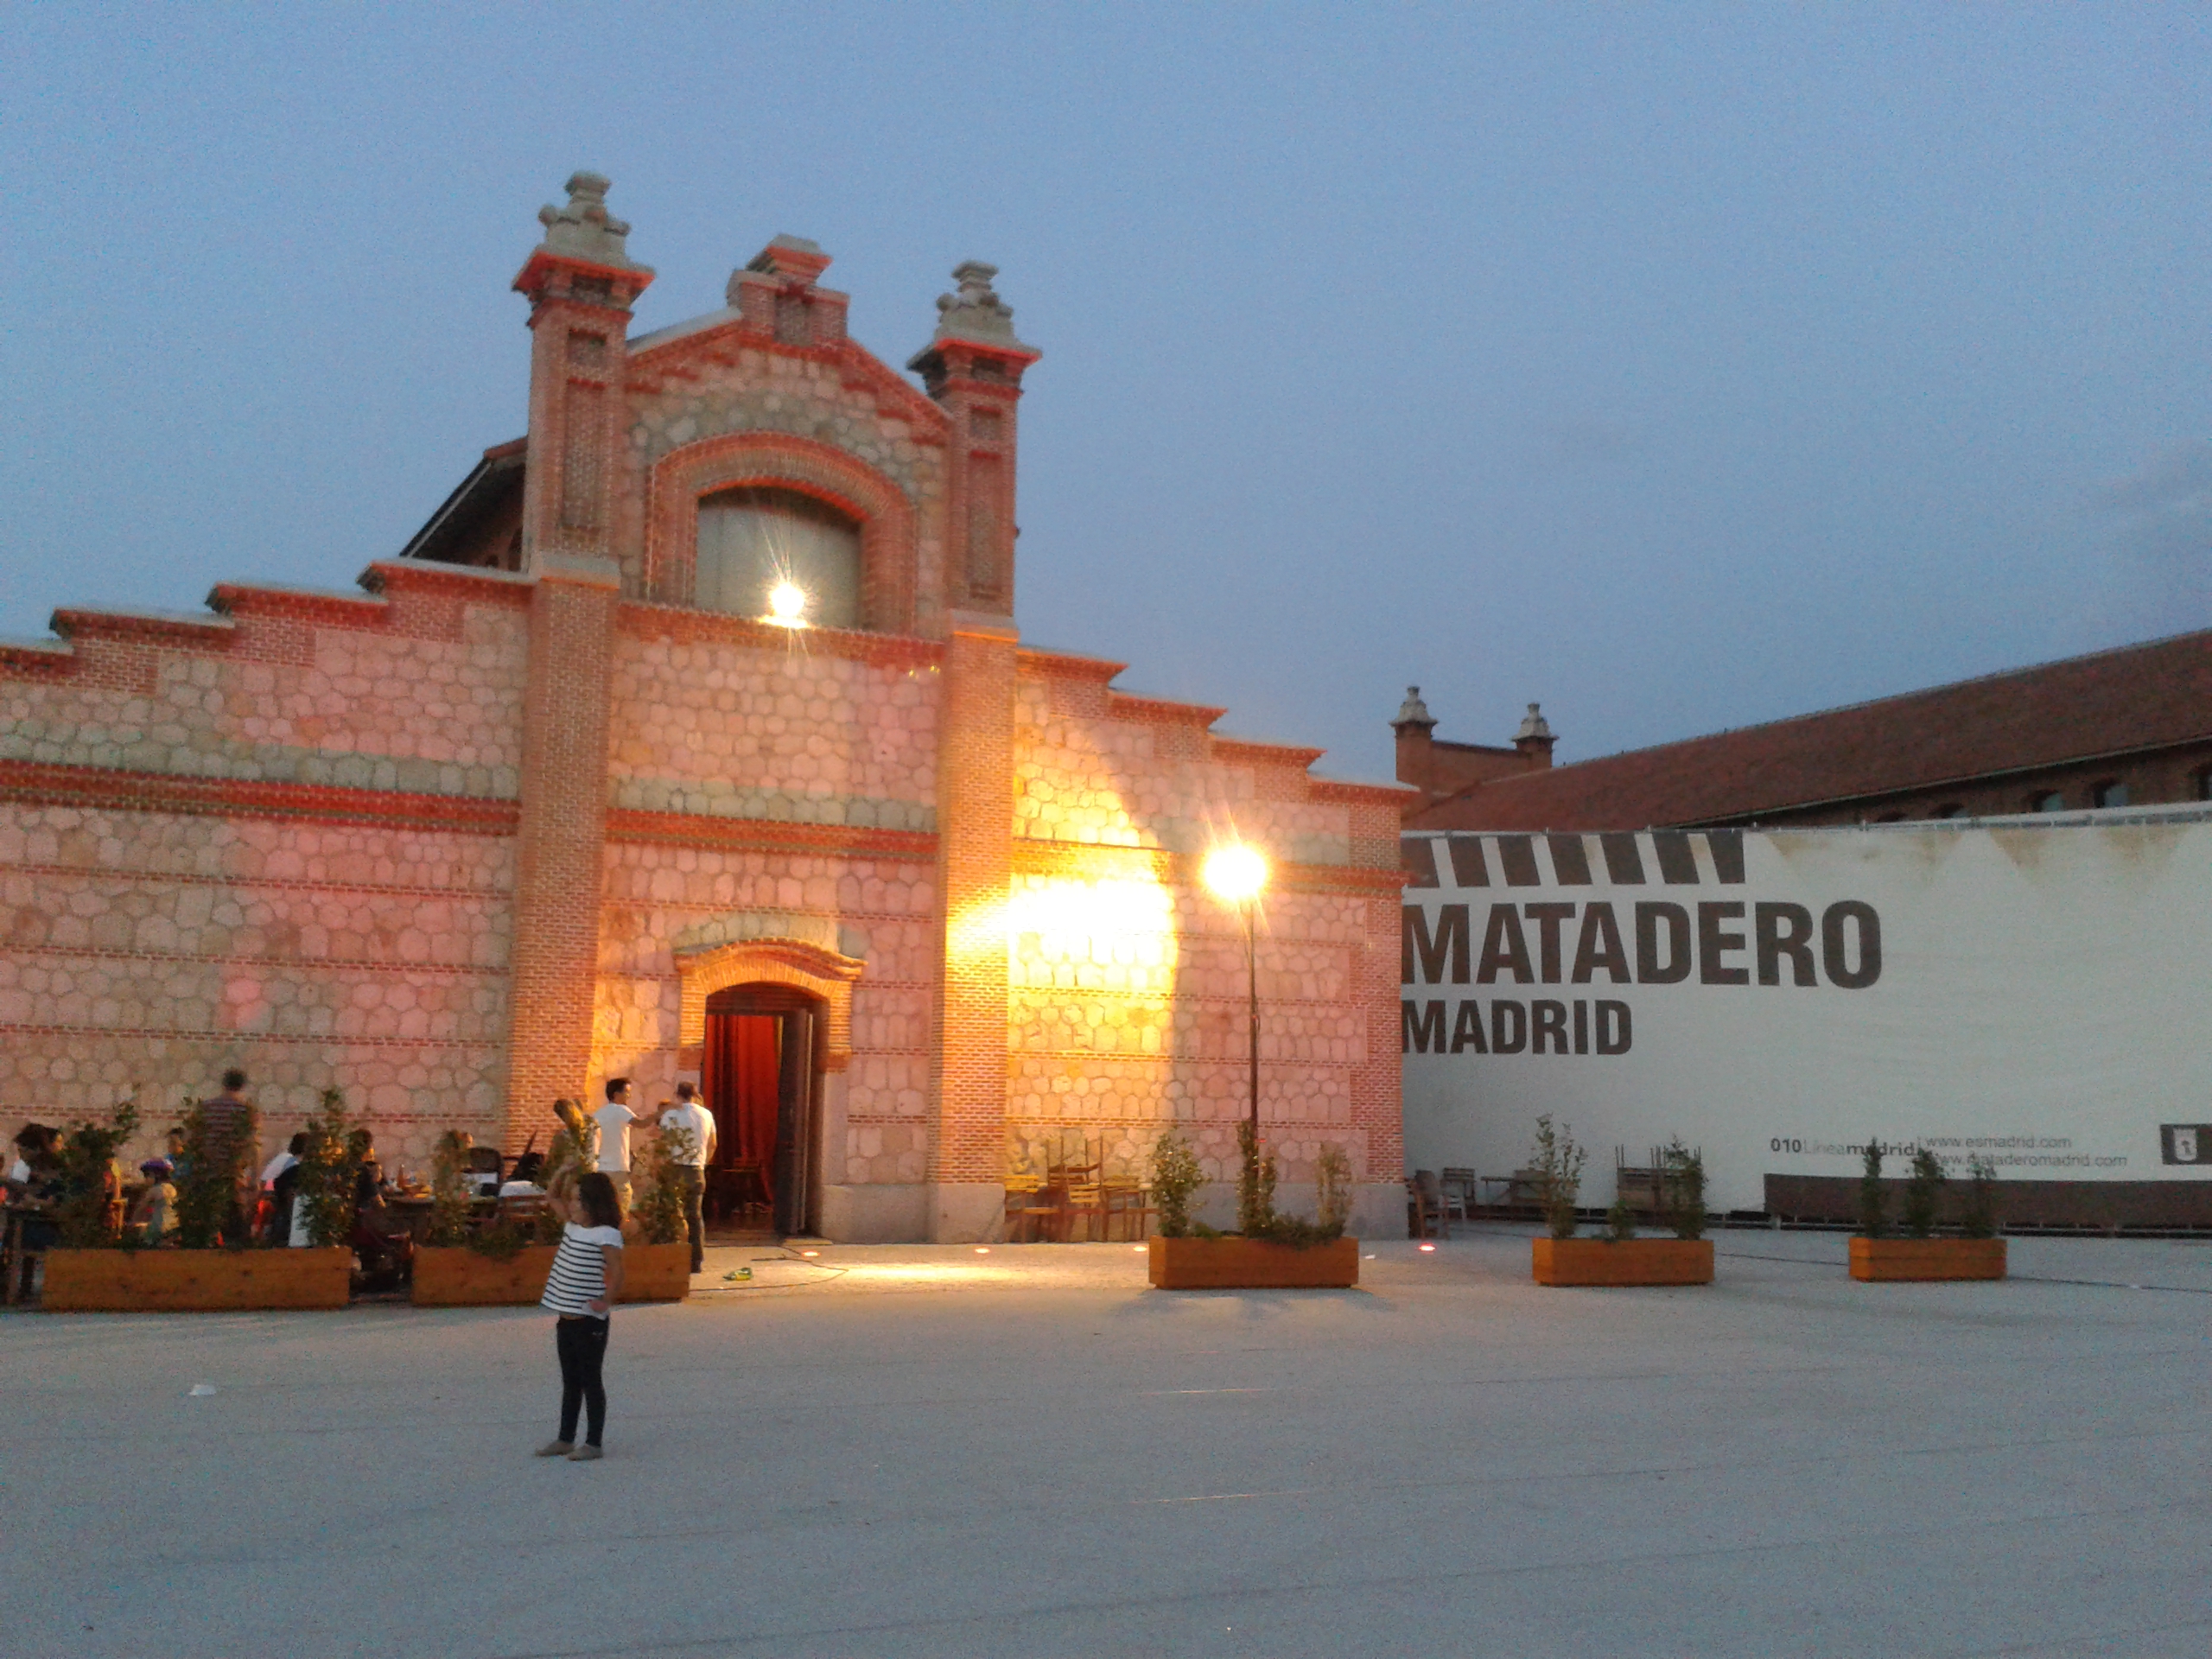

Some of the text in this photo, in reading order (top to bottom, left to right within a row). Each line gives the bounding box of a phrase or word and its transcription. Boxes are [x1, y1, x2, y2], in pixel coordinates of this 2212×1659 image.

[1402, 899, 1882, 989] MATADERO
[1402, 999, 1633, 1055] MADRID
[1926, 1135, 2072, 1149] www.esmadrid.com
